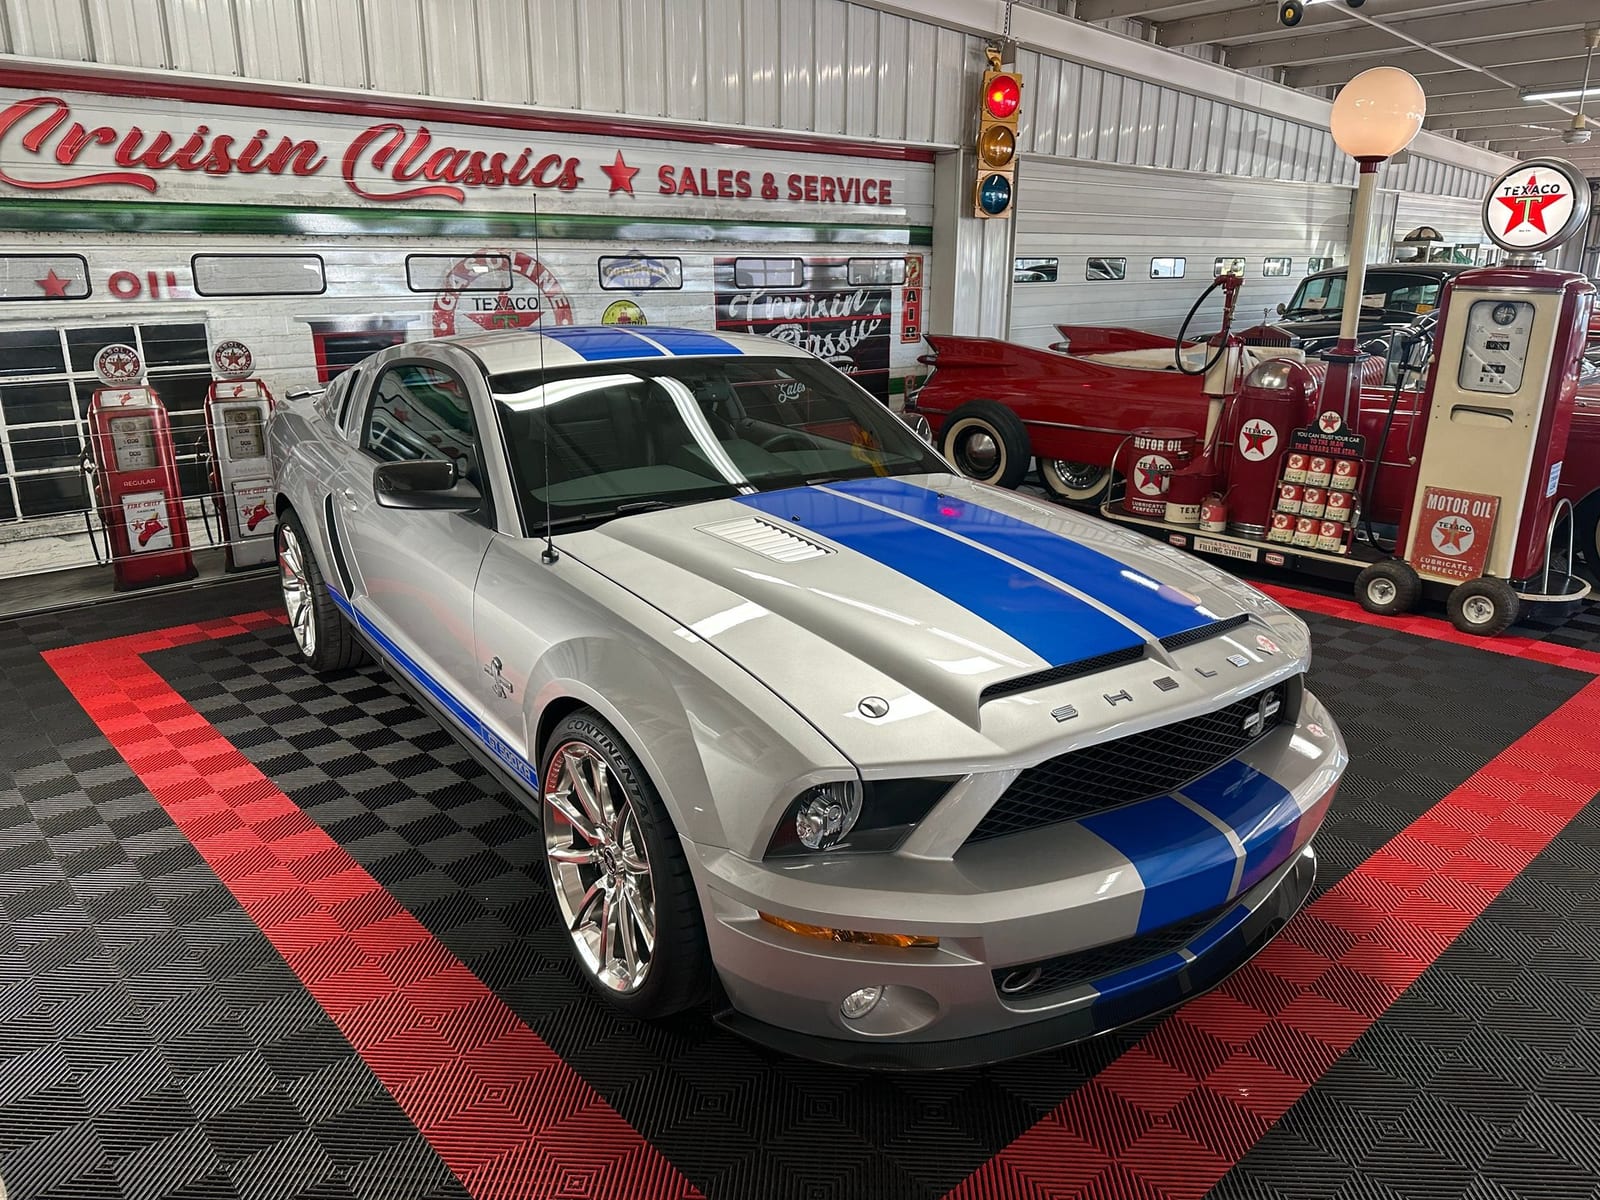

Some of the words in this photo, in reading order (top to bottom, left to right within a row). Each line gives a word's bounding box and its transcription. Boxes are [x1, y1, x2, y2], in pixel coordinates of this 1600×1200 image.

[0, 97, 328, 192] Cruisin
[342, 123, 584, 204] Classics
[658, 164, 751, 199] SALES
[761, 171, 779, 200] &
[787, 174, 893, 206] SERVICE
[1503, 183, 1561, 197] TEXACO
[107, 270, 192, 300] OIL
[437, 247, 570, 311] GASOLINE
[472, 297, 539, 312] TEXACO
[905, 289, 918, 338] AIR
[776, 381, 806, 404] Sales
[1244, 426, 1272, 435] TEXACO
[1134, 436, 1165, 452] MOTOR
[1167, 440, 1182, 452] OIL
[123, 478, 156, 487] REGULAR
[1132, 506, 1165, 514] PERFECTLY
[1426, 493, 1469, 515] MOTOR
[1471, 500, 1492, 519] OIL
[1438, 521, 1473, 533] TEXACO
[1199, 543, 1223, 554] FILLING
[1223, 548, 1252, 559] STATION
[1419, 556, 1474, 572] LUBRICATES
[1420, 563, 1470, 578] PERFECTLY
